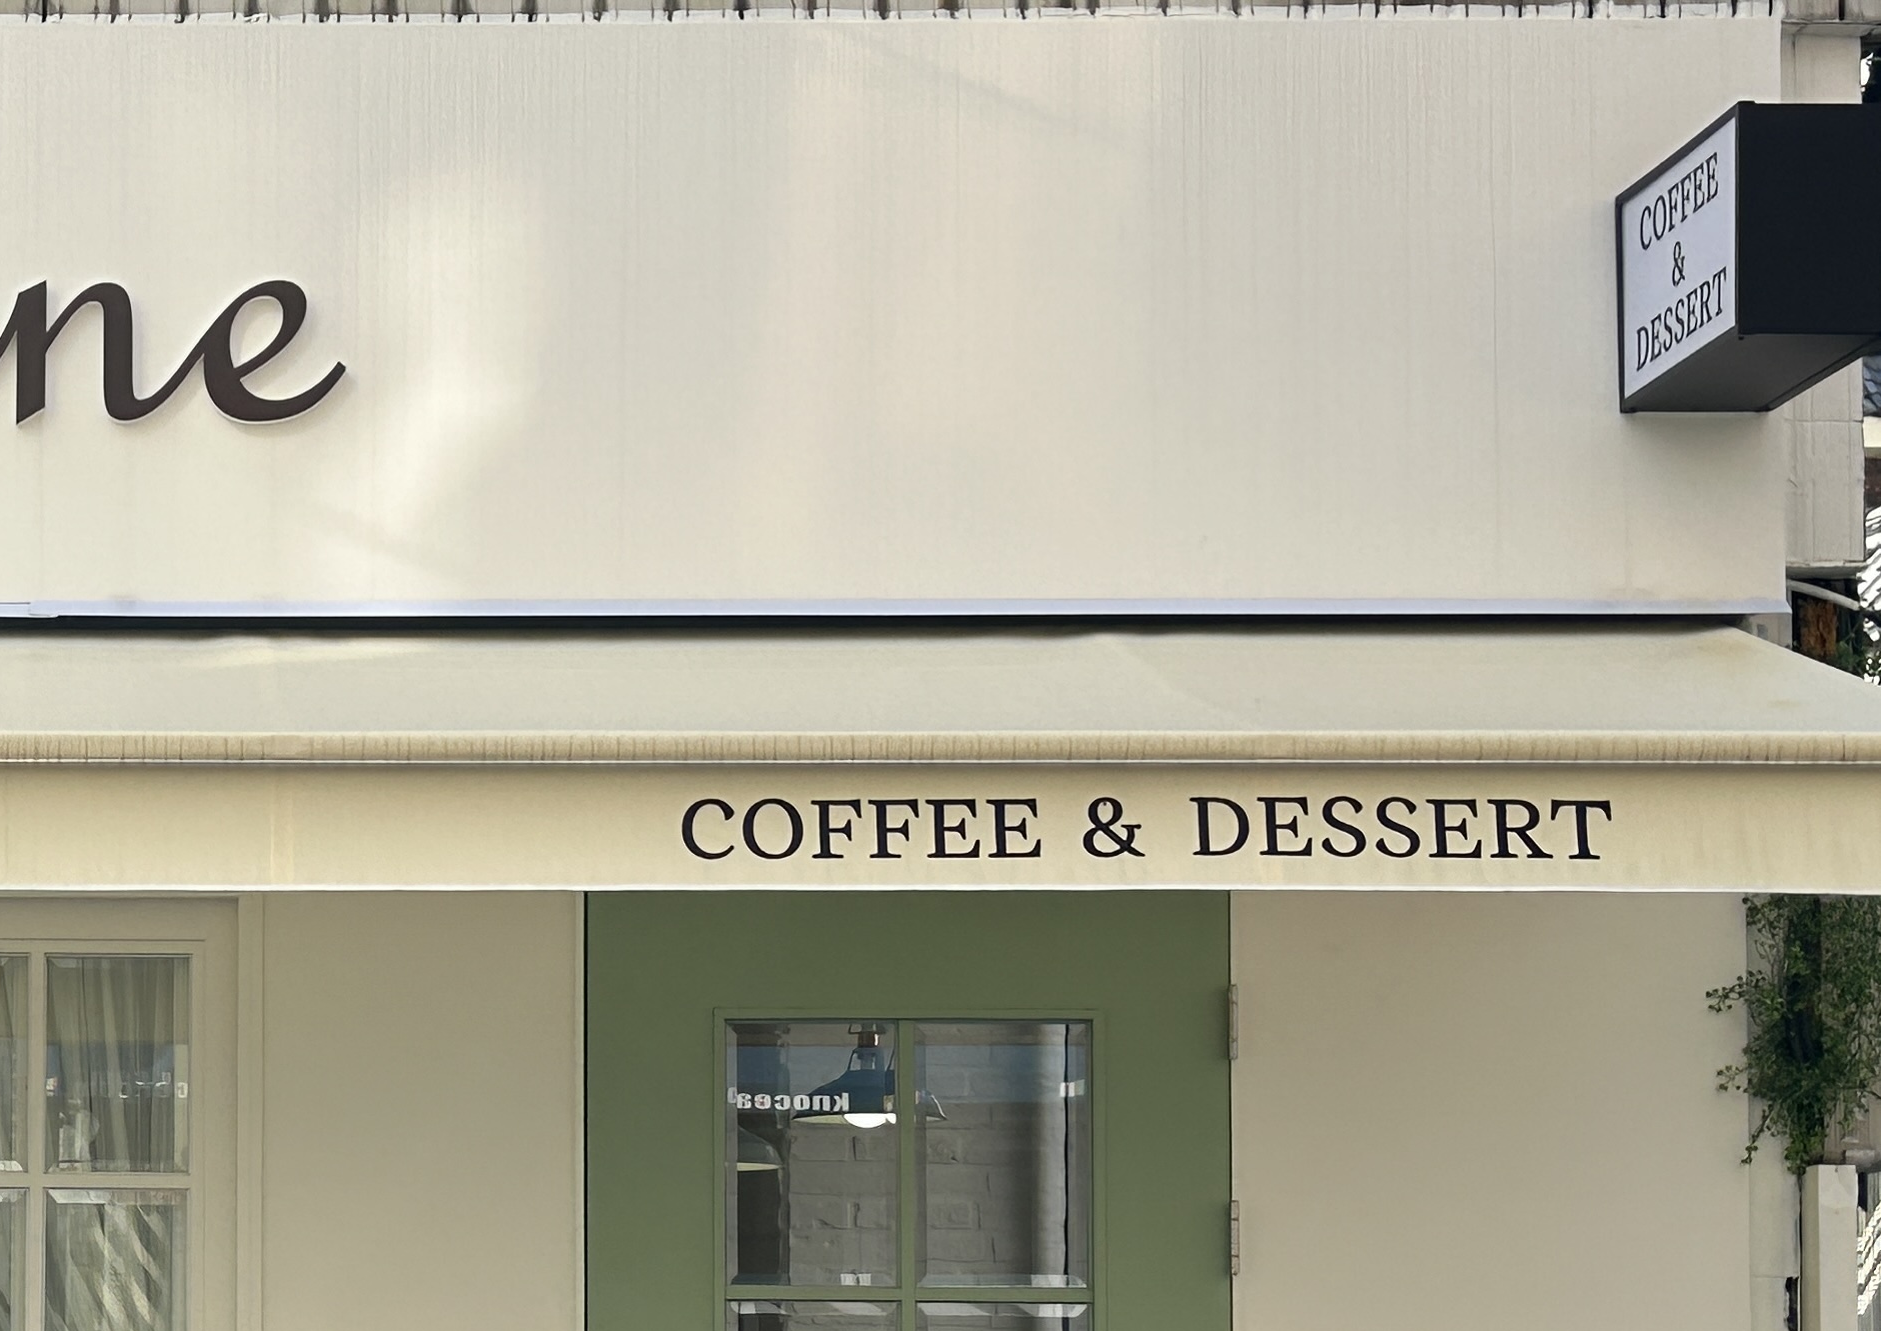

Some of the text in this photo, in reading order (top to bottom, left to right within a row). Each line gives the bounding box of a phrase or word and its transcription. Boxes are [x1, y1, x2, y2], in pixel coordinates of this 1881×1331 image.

[1639, 152, 1719, 250] COFFEE
[1671, 241, 1686, 287] &
[1636, 266, 1727, 372] DESSERT
[681, 796, 1612, 860] COFFEE & DESSERT
